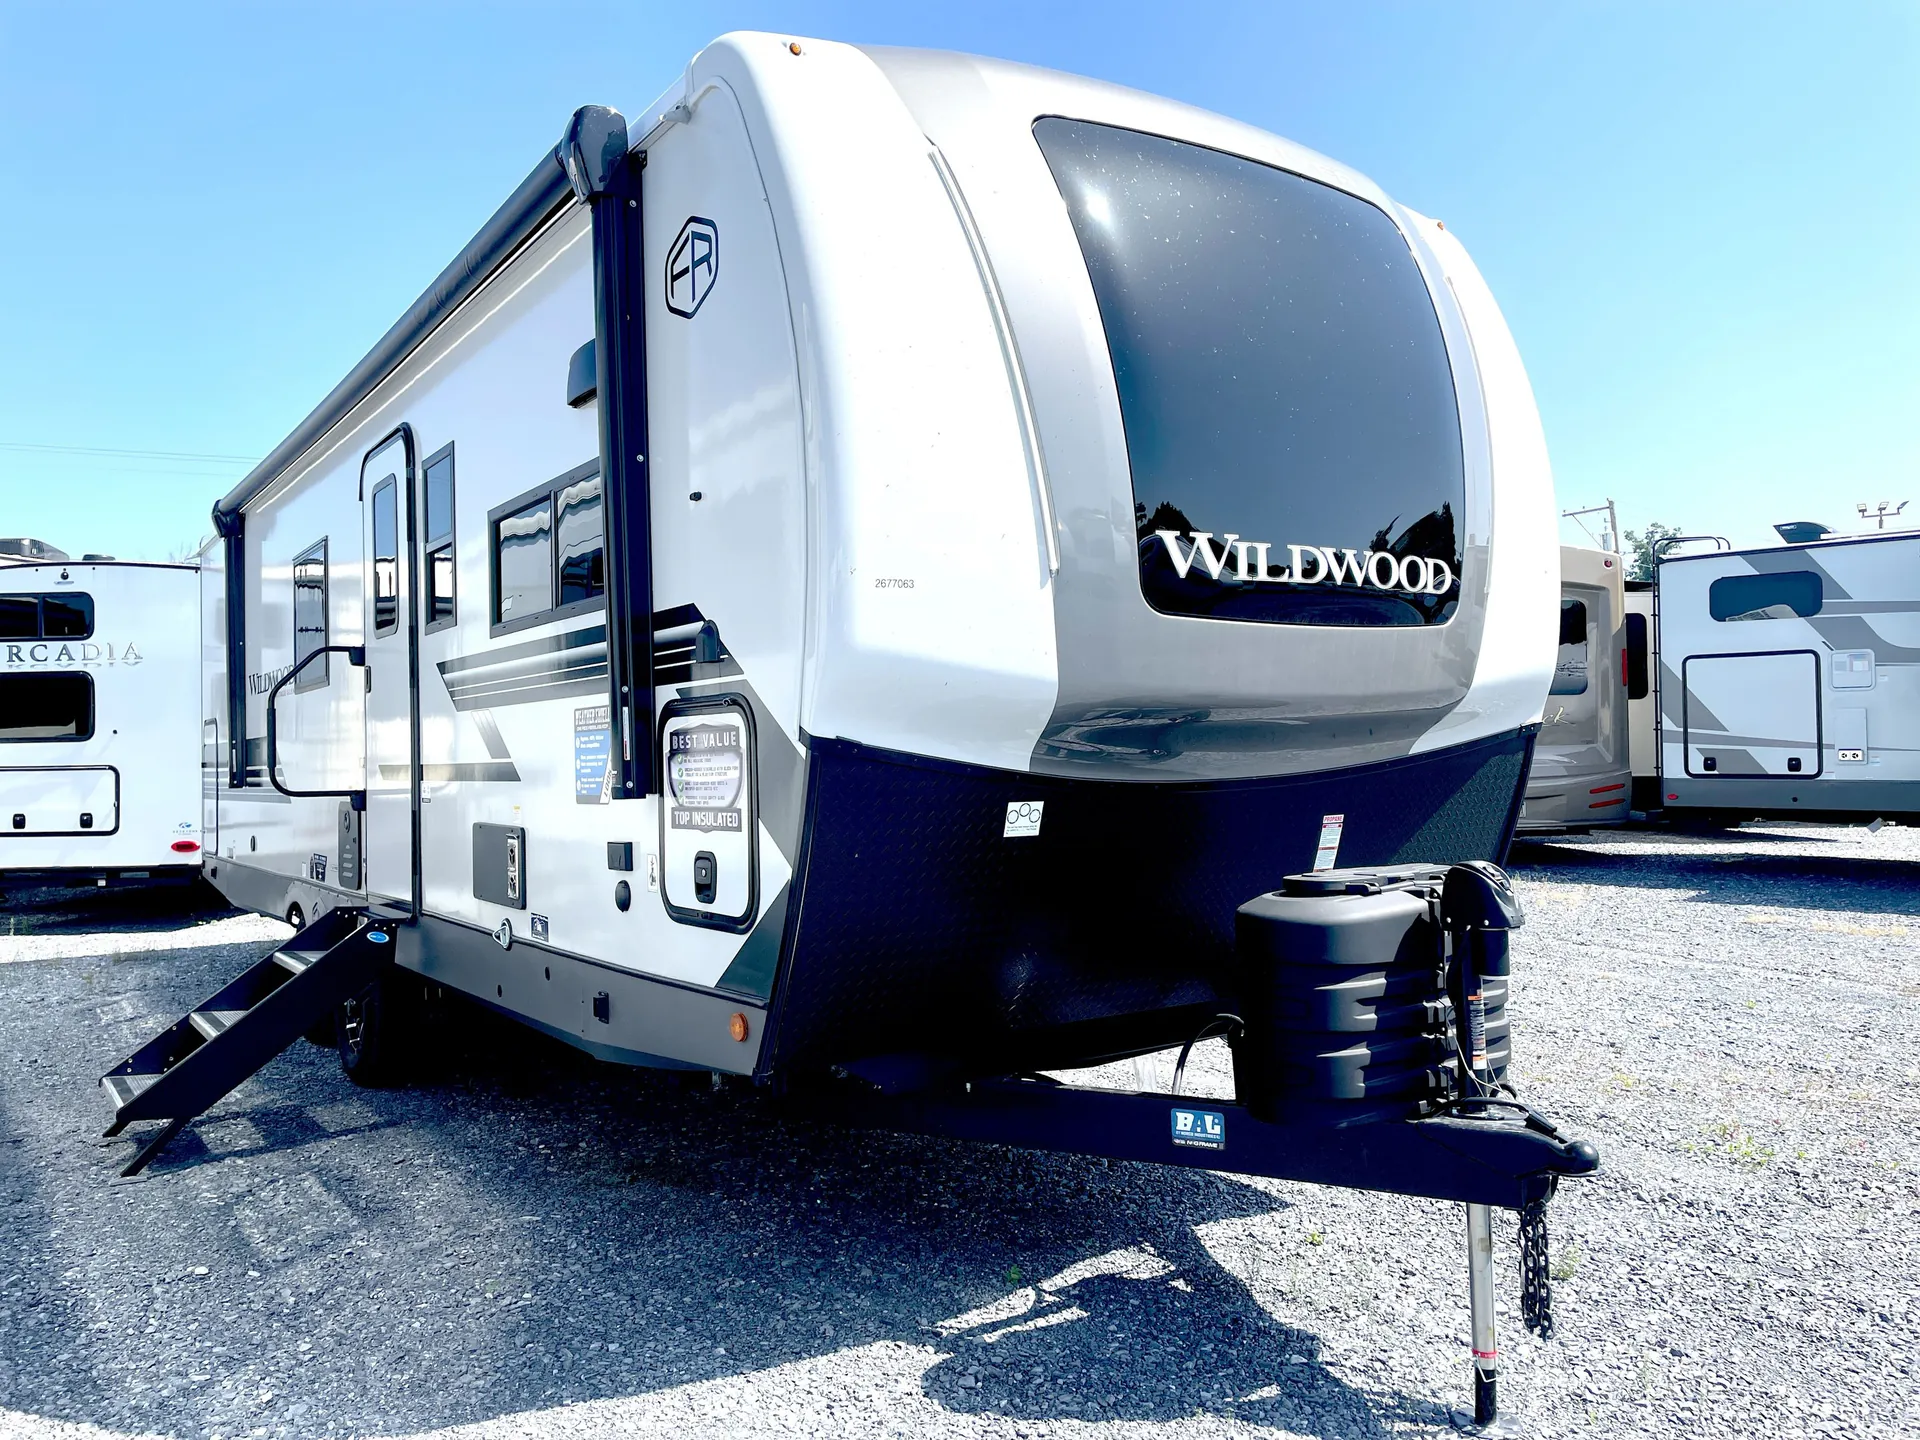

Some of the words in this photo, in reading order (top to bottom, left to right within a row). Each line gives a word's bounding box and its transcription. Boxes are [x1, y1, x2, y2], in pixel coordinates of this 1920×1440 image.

[1155, 529, 1452, 595] WILDWOOD
[875, 578, 915, 589] 2677063
[672, 734, 698, 750] BEST
[702, 731, 737, 748] VALUE
[674, 810, 690, 825] TOP
[692, 811, 739, 828] INSULATED
